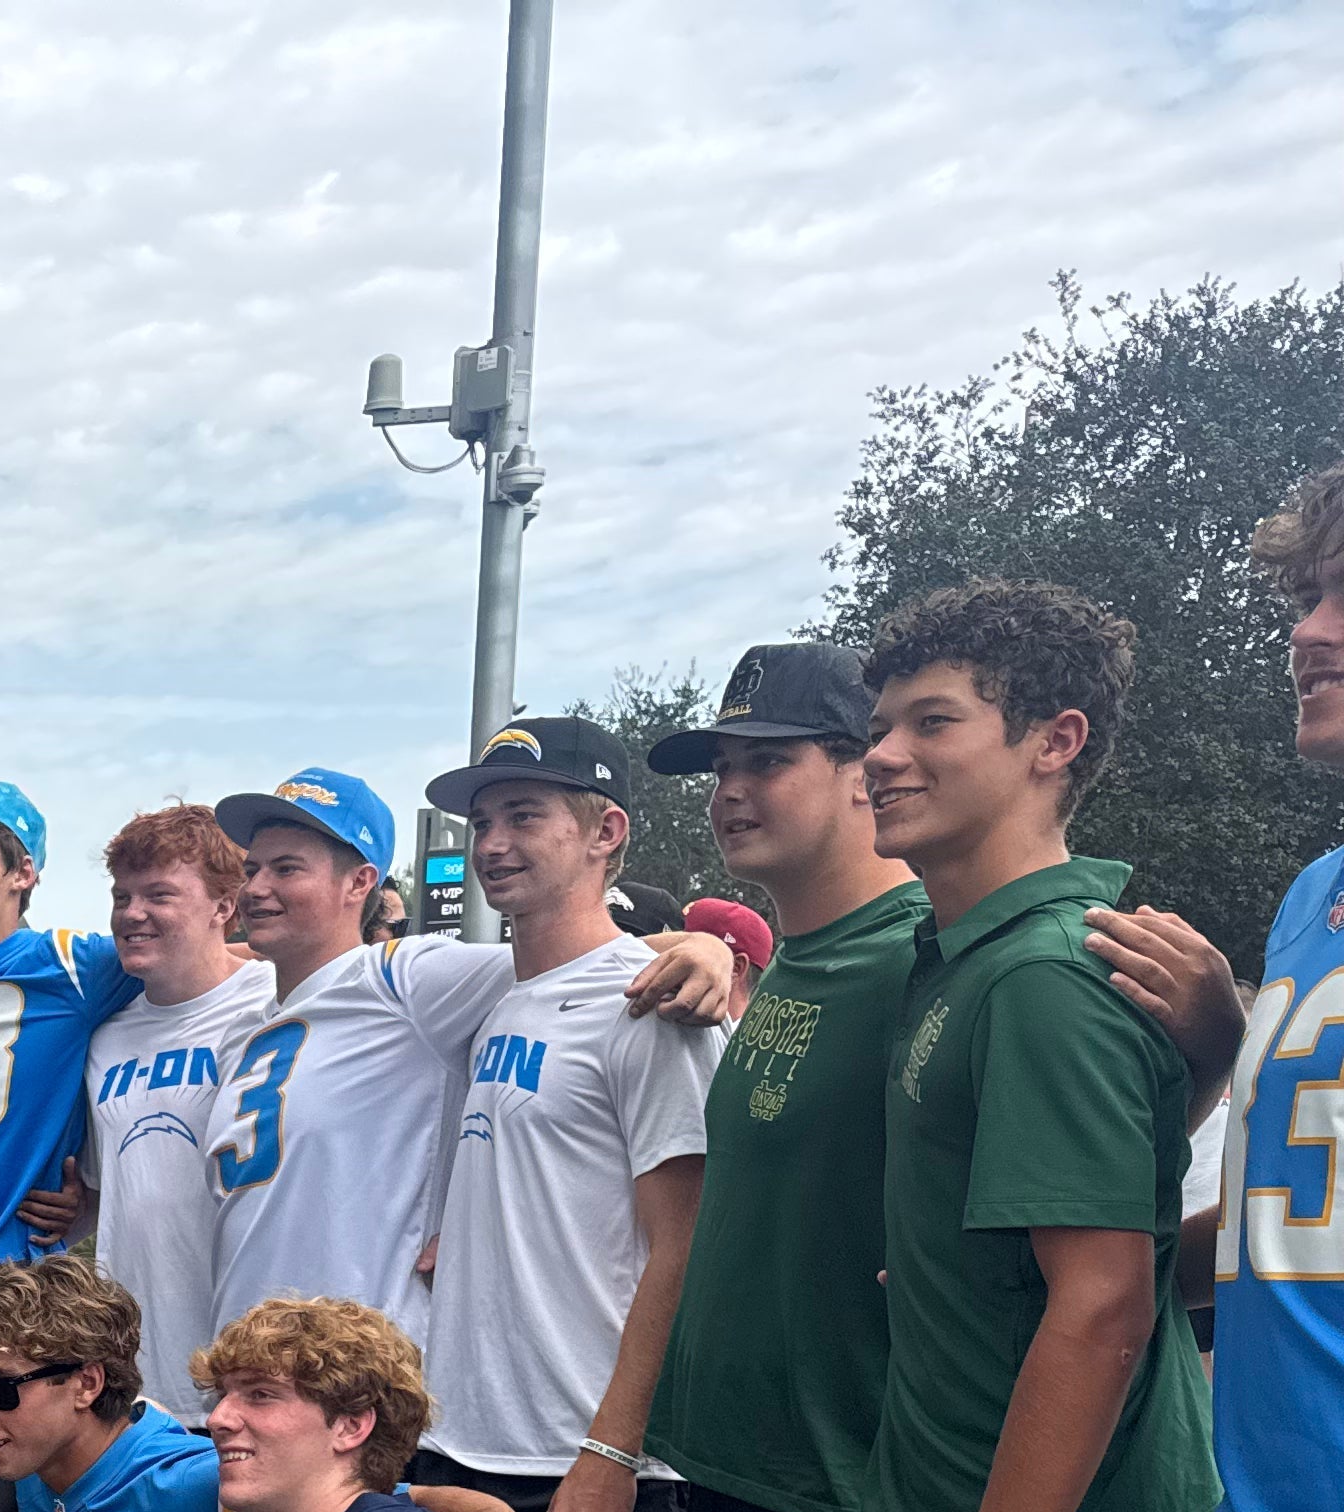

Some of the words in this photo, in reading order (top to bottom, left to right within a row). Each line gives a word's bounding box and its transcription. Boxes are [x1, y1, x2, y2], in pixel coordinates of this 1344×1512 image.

[441, 887, 464, 898] VIP
[738, 992, 821, 1058] COSTA
[97, 1047, 218, 1106] 11-ON
[212, 1017, 310, 1197] 3
